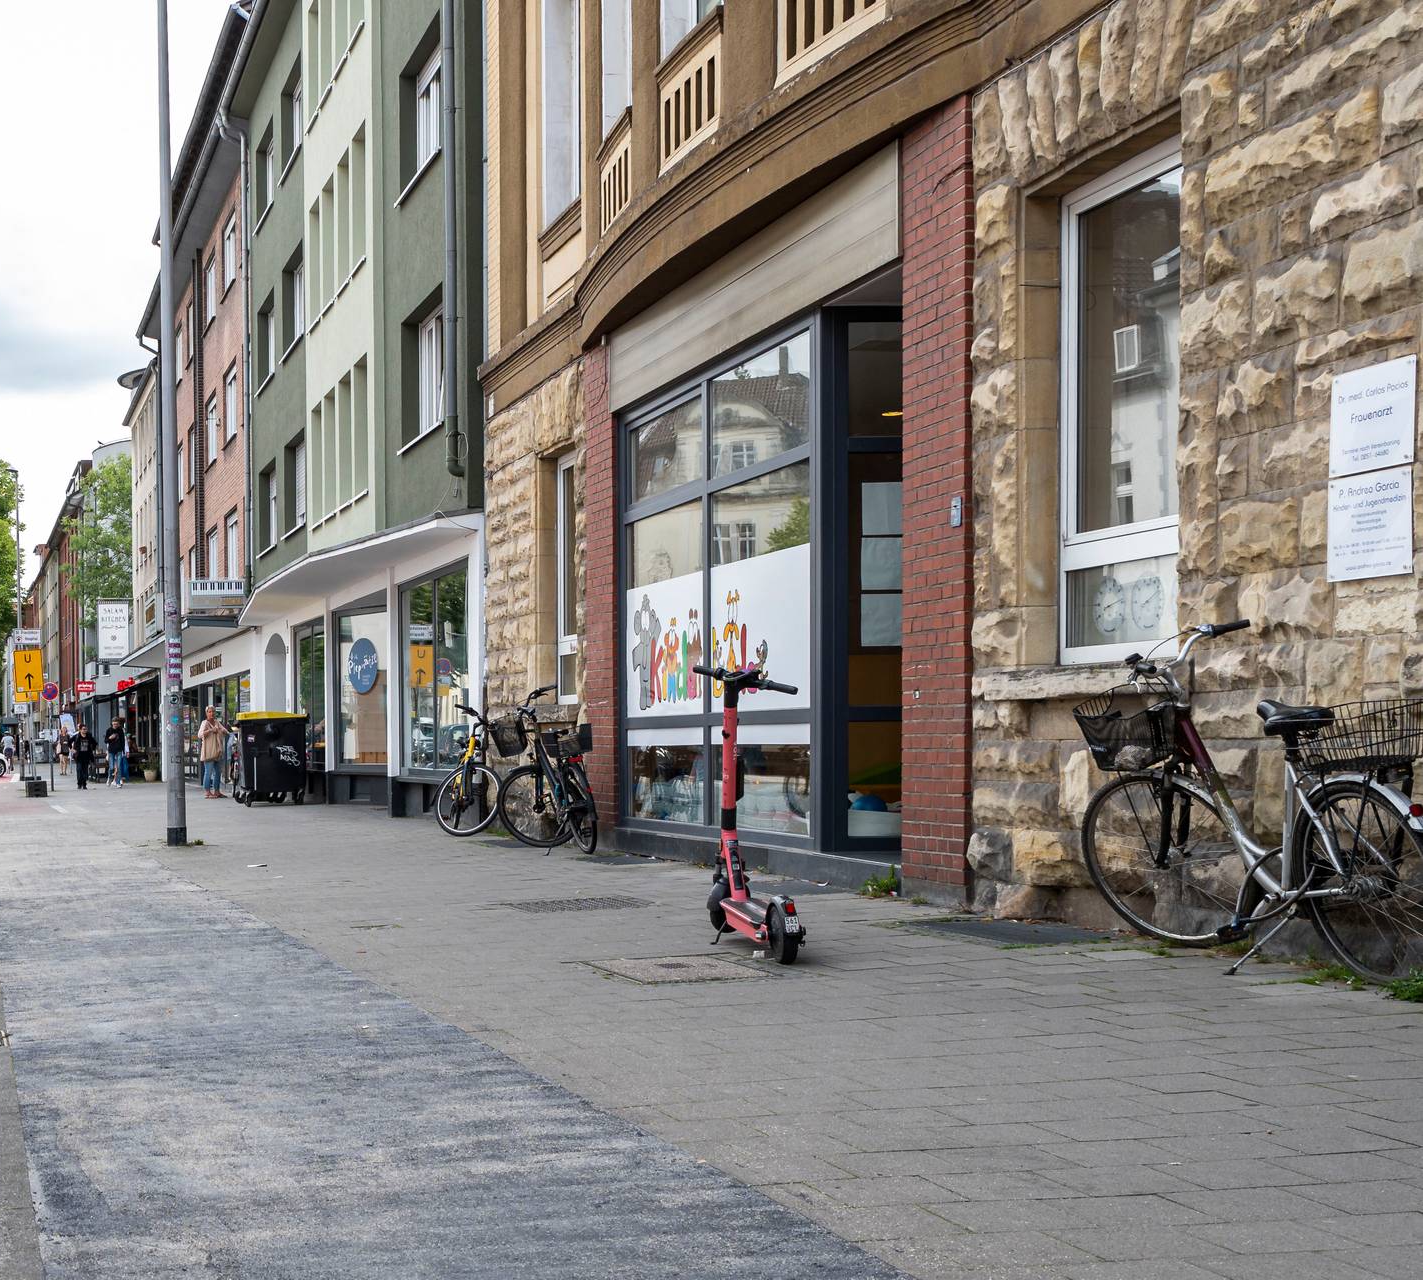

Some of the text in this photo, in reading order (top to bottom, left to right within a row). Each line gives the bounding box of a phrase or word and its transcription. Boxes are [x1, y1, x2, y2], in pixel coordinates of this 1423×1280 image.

[1350, 406, 1393, 424] Frauenarzt
[1347, 485, 1374, 497] Andrea
[1353, 501, 1364, 509] und
[1364, 494, 1407, 509] Jugendmedizin
[24, 653, 32, 663] U
